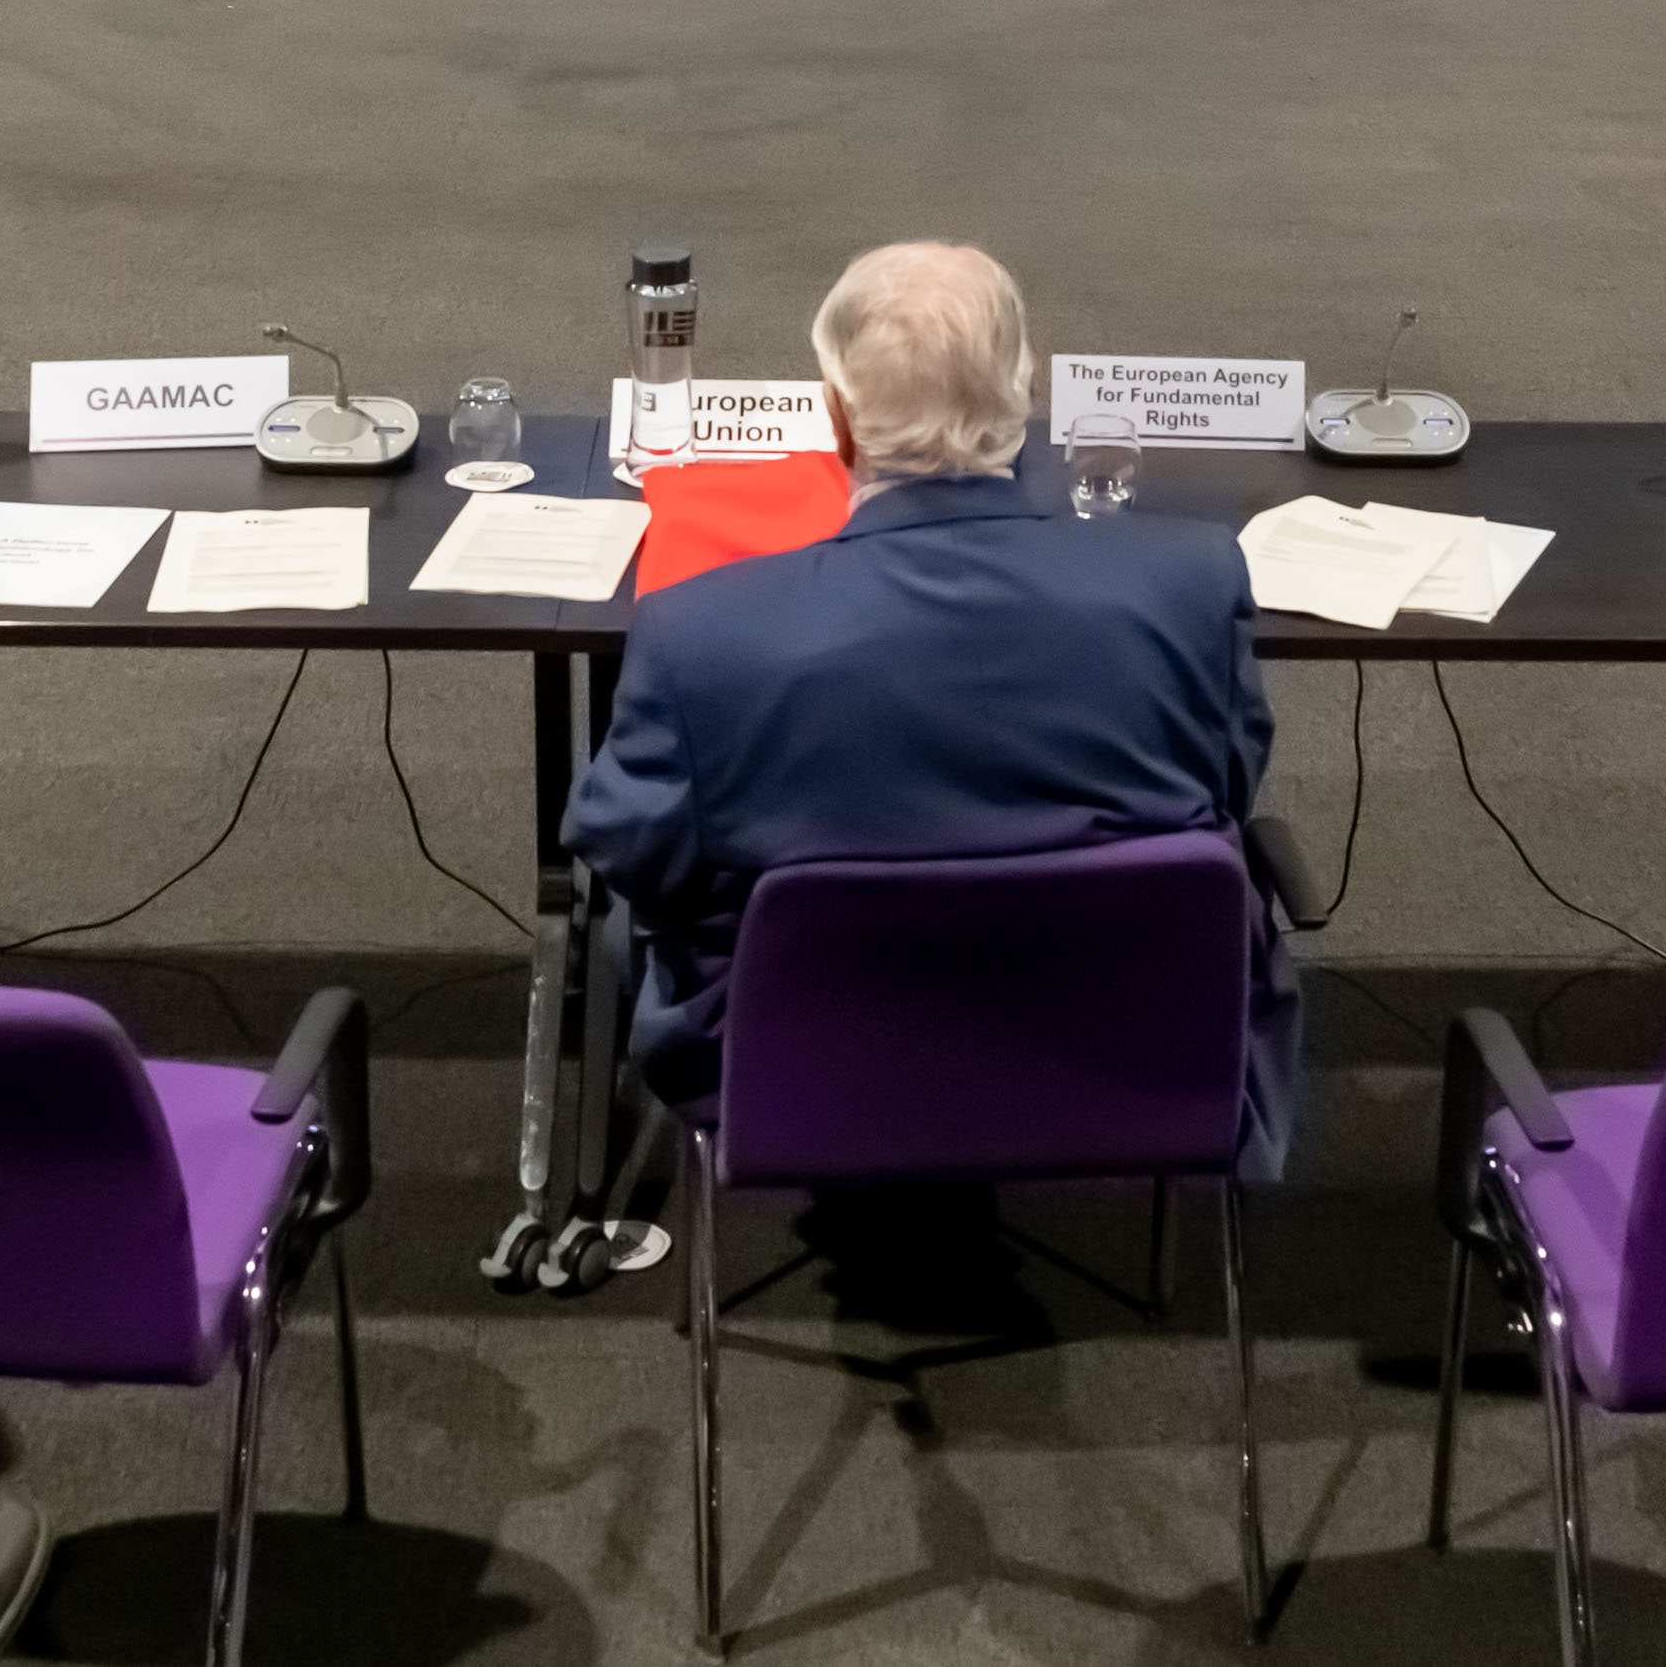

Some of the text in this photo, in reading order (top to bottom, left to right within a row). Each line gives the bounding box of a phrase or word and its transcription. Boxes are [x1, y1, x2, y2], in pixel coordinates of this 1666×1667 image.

[1069, 364, 1288, 389] The European Agency
[86, 383, 234, 411] GAAMAC
[691, 394, 814, 417] uropean
[1097, 386, 1260, 407] for Fundamental
[694, 420, 783, 442] Union
[1146, 410, 1210, 430] Rights
